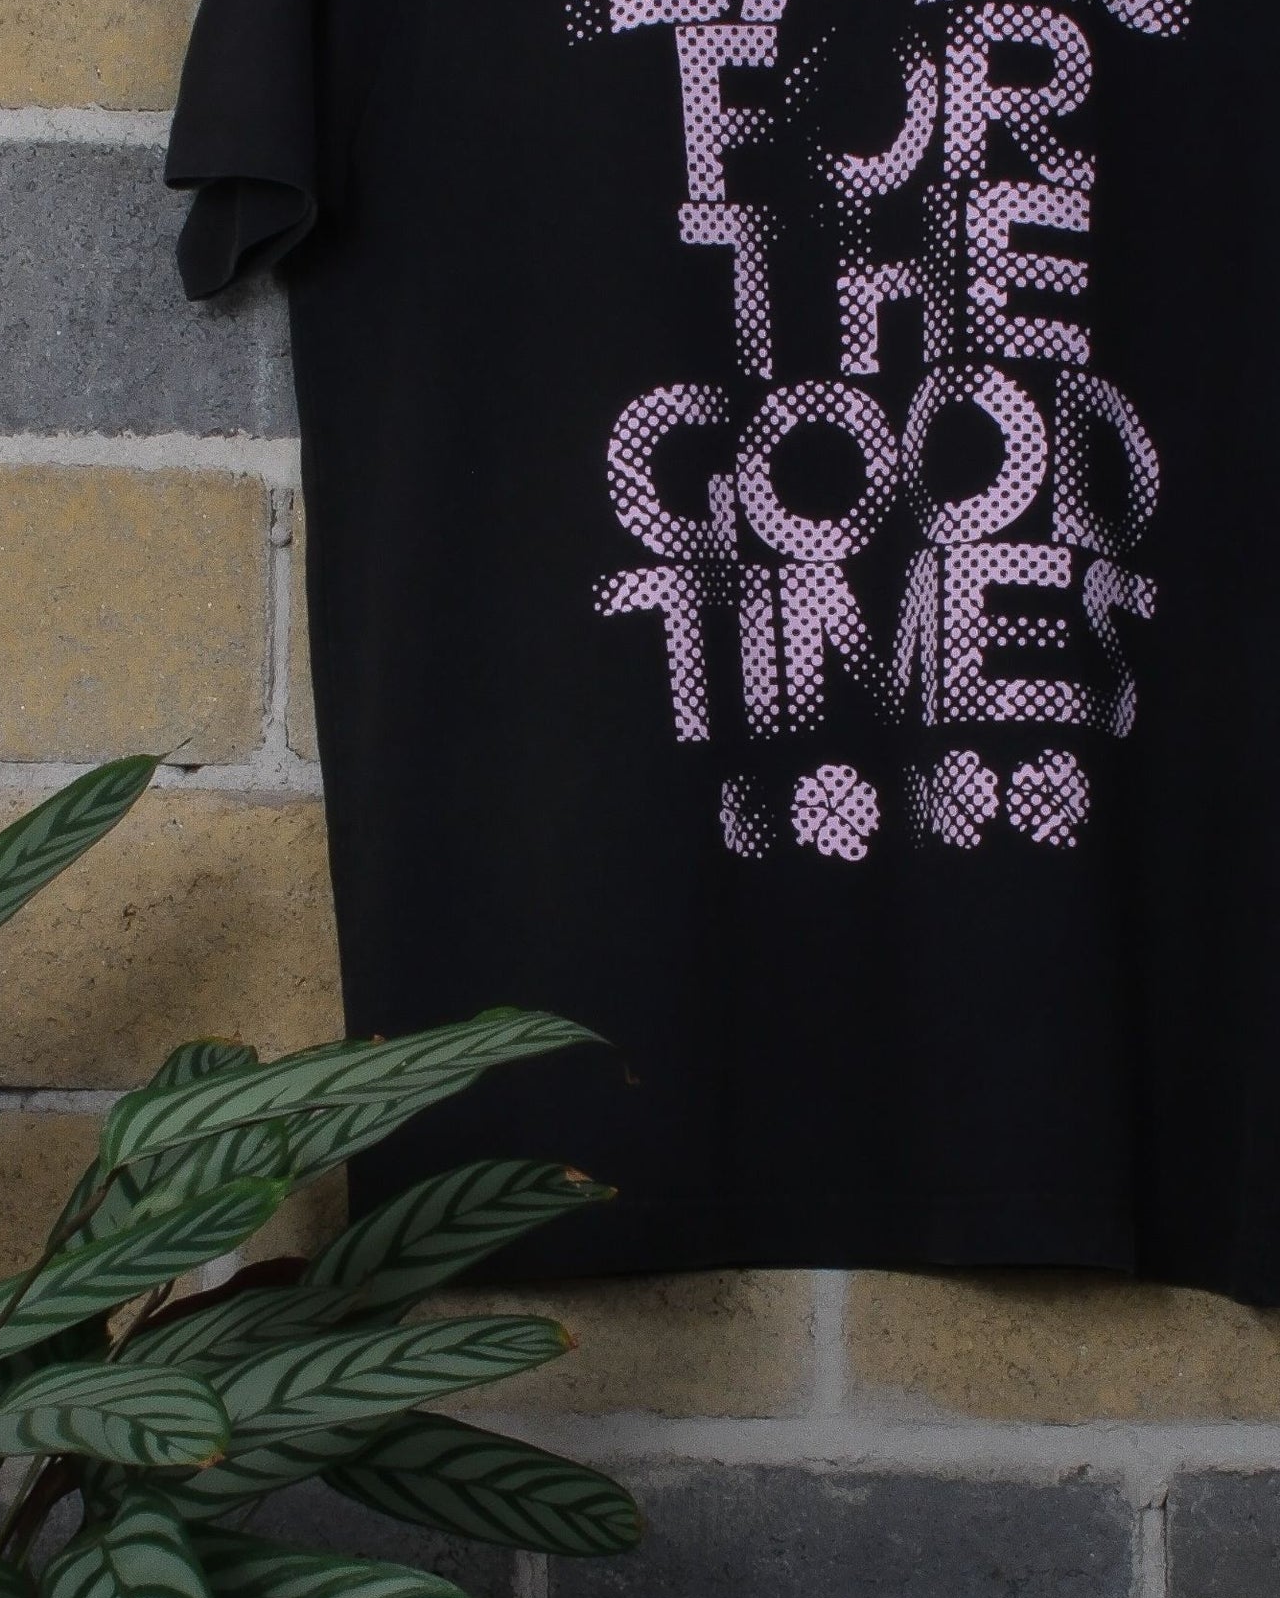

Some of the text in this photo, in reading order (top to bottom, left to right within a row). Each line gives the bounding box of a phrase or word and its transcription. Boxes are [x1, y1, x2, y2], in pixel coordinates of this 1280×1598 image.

[674, 2, 1096, 201] FOR
[677, 181, 1092, 379] THE
[606, 362, 1160, 562] GOOD
[592, 541, 1158, 743] TIMES
